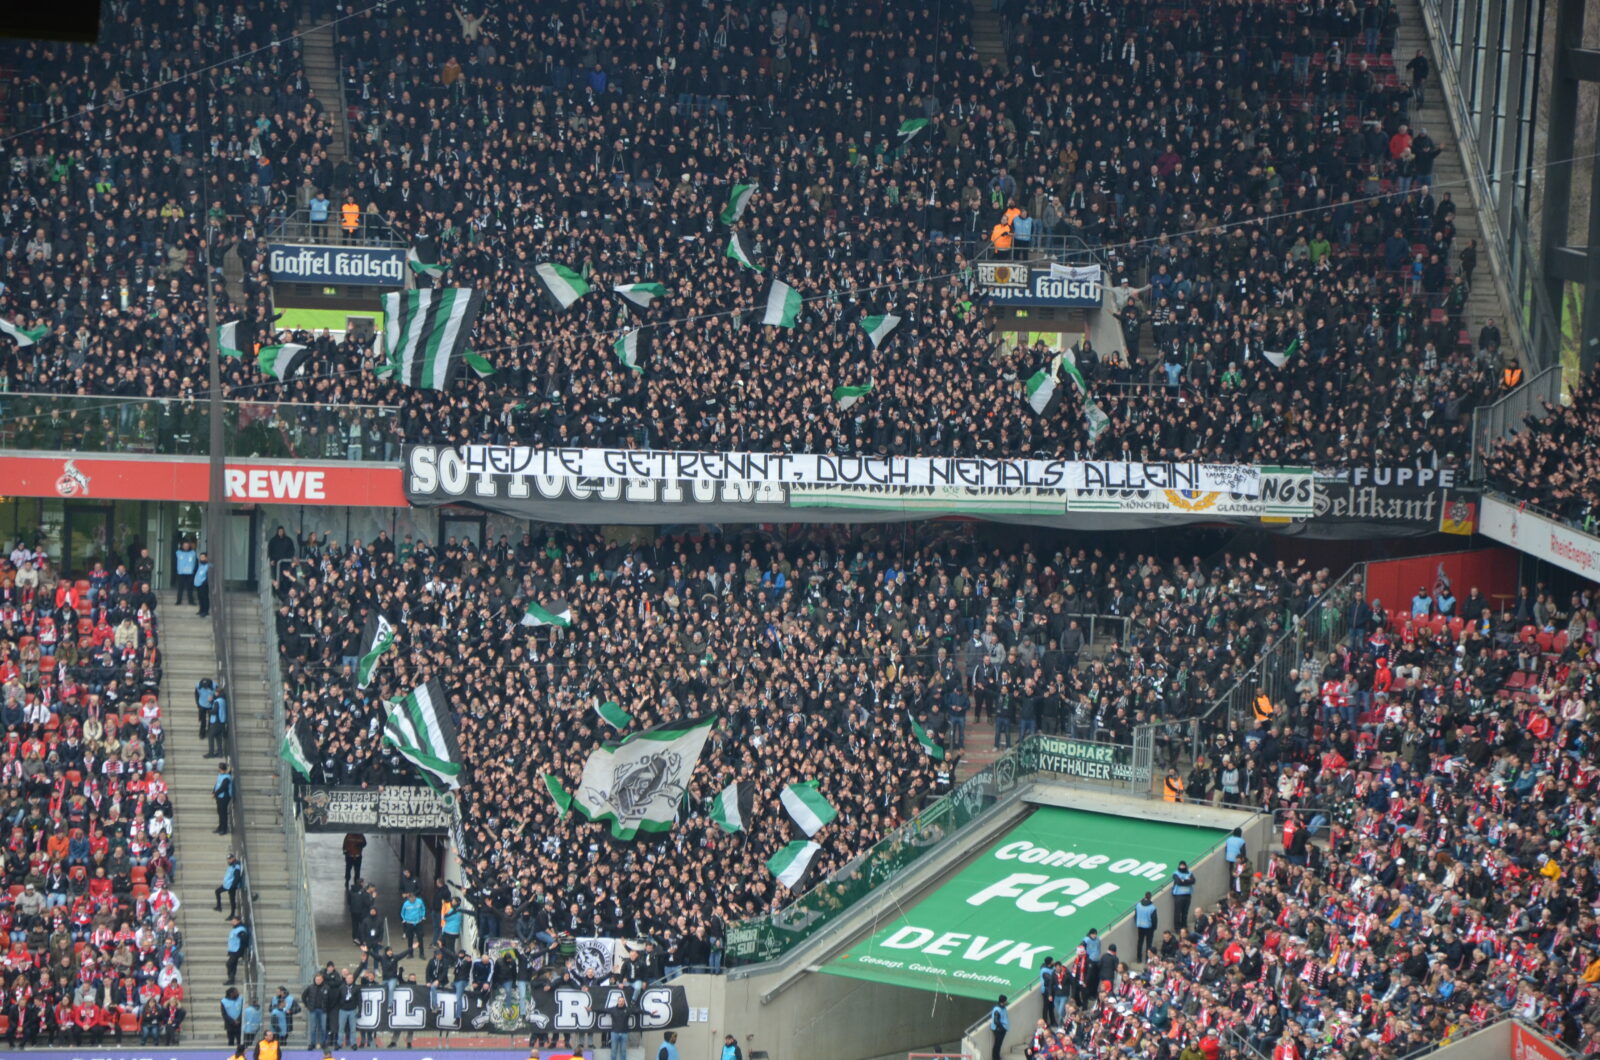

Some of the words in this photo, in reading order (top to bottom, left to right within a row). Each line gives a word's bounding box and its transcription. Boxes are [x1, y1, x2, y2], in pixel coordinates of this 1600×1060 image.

[270, 248, 333, 276] Gaffel
[335, 252, 404, 281] Kölsch
[466, 446, 583, 475] HEUTE
[817, 455, 909, 484] DOCH
[930, 457, 1065, 487] NIEMALS
[1085, 460, 1199, 489] ALLEIN!
[1353, 467, 1456, 487] FUPPE
[224, 469, 326, 499] REWE
[1119, 499, 1170, 511] MÖNCHEN
[1217, 503, 1266, 513] GLADBACH
[1313, 485, 1436, 521] Selfkant
[1040, 738, 1114, 762] NORDHARZ
[380, 785, 442, 801] BEGLEI
[327, 811, 378, 825] EINIGES
[329, 801, 375, 813] GEHT
[379, 800, 441, 815] SERVICE
[994, 840, 1111, 870] Come
[1107, 858, 1169, 882] on,
[965, 872, 1121, 918] FC!
[879, 926, 1056, 970] DEVK
[908, 963, 948, 976] Getan.
[952, 969, 1013, 987] Geholfen.
